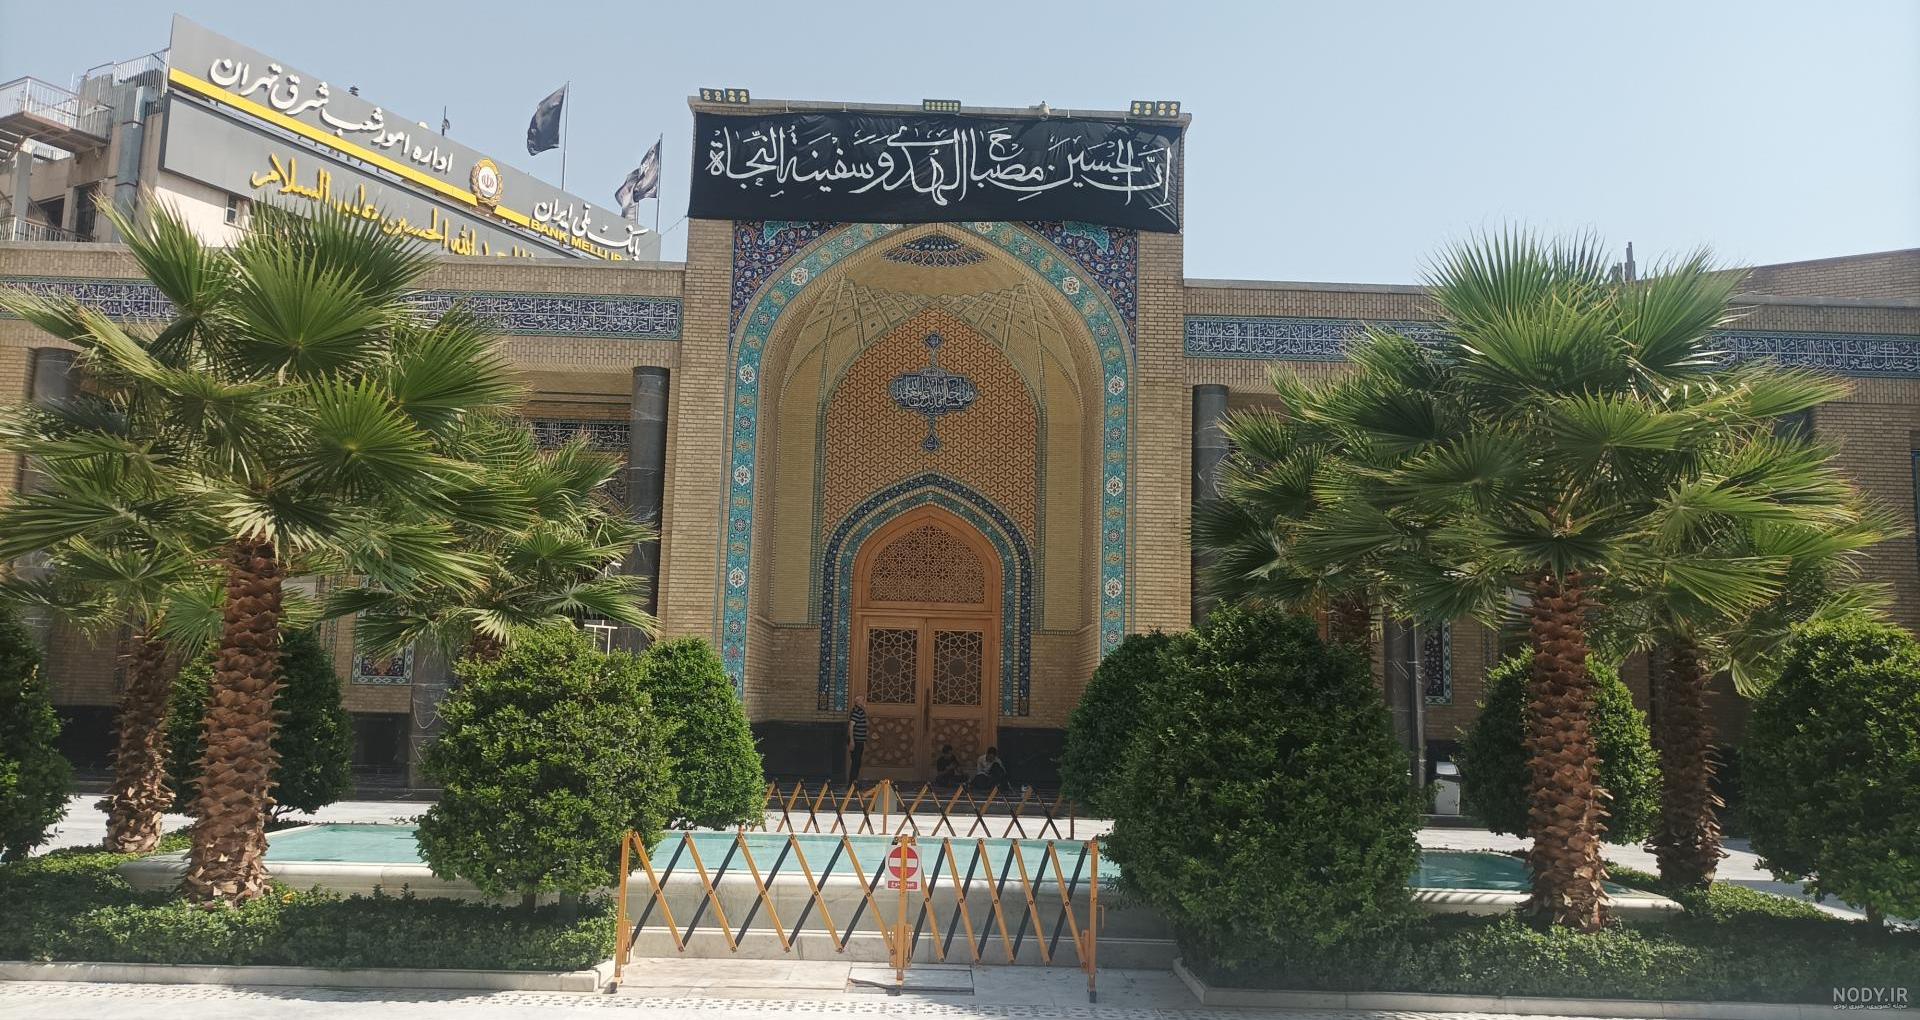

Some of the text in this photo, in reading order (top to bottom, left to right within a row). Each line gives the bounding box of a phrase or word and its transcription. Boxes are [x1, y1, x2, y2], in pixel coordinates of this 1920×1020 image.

[209, 58, 453, 173] اداره امور شعب شرق تهران
[530, 218, 569, 243] BANK
[571, 235, 608, 259] MELLI
[533, 199, 649, 261] بانک ملی ایران
